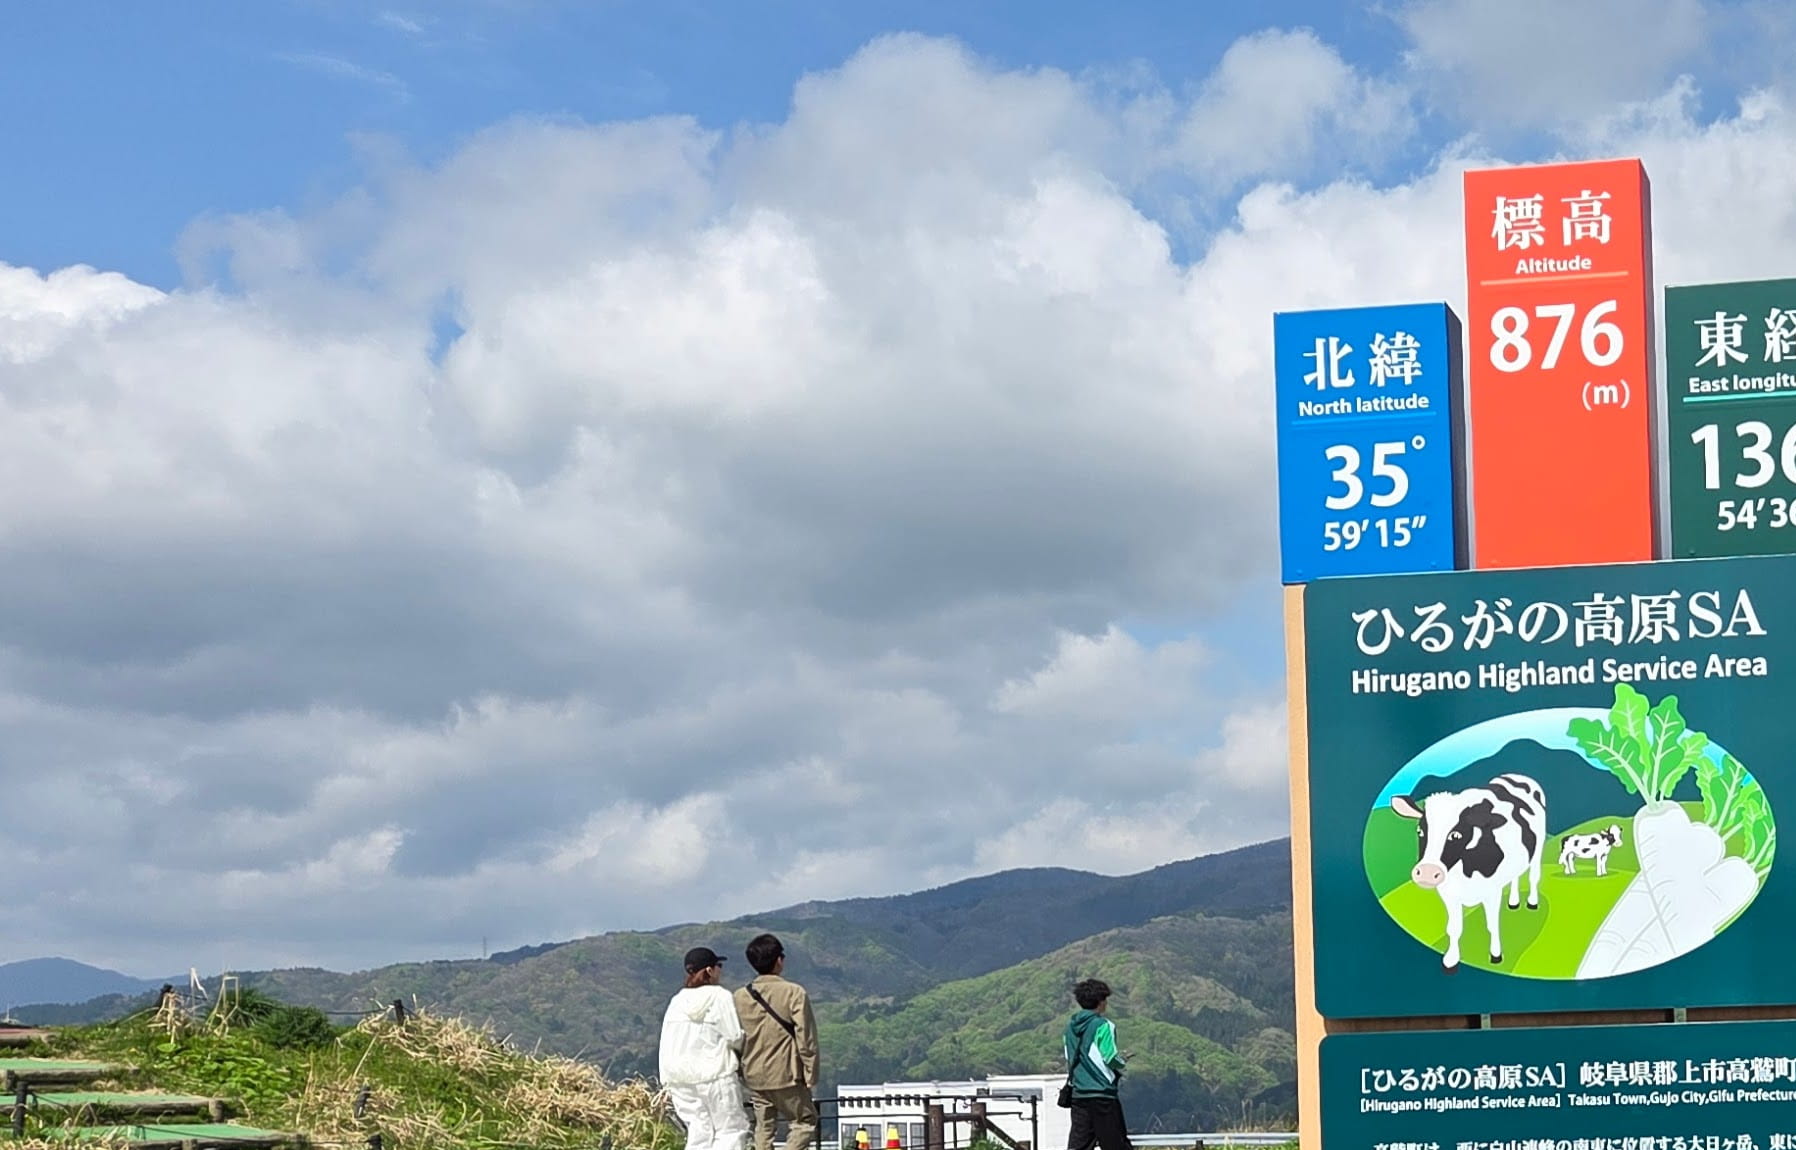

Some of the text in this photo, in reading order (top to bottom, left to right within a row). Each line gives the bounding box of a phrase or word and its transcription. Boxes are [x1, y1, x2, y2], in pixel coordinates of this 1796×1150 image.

[1491, 189, 1612, 251] 標高
[1515, 255, 1592, 275] Altitude
[1489, 299, 1624, 373] 876
[1303, 331, 1423, 391] 北緯
[1582, 379, 1630, 411] (m)
[1688, 377, 1729, 393] East
[1298, 393, 1429, 417] North latitude
[1351, 589, 1768, 659] ひるがの高原SA
[1352, 653, 1768, 697] Hirugano Highland Service Area
[1424, 1096, 1479, 1113] Highland
[1481, 1094, 1525, 1108] Service
[1567, 1092, 1610, 1106] Takasu
